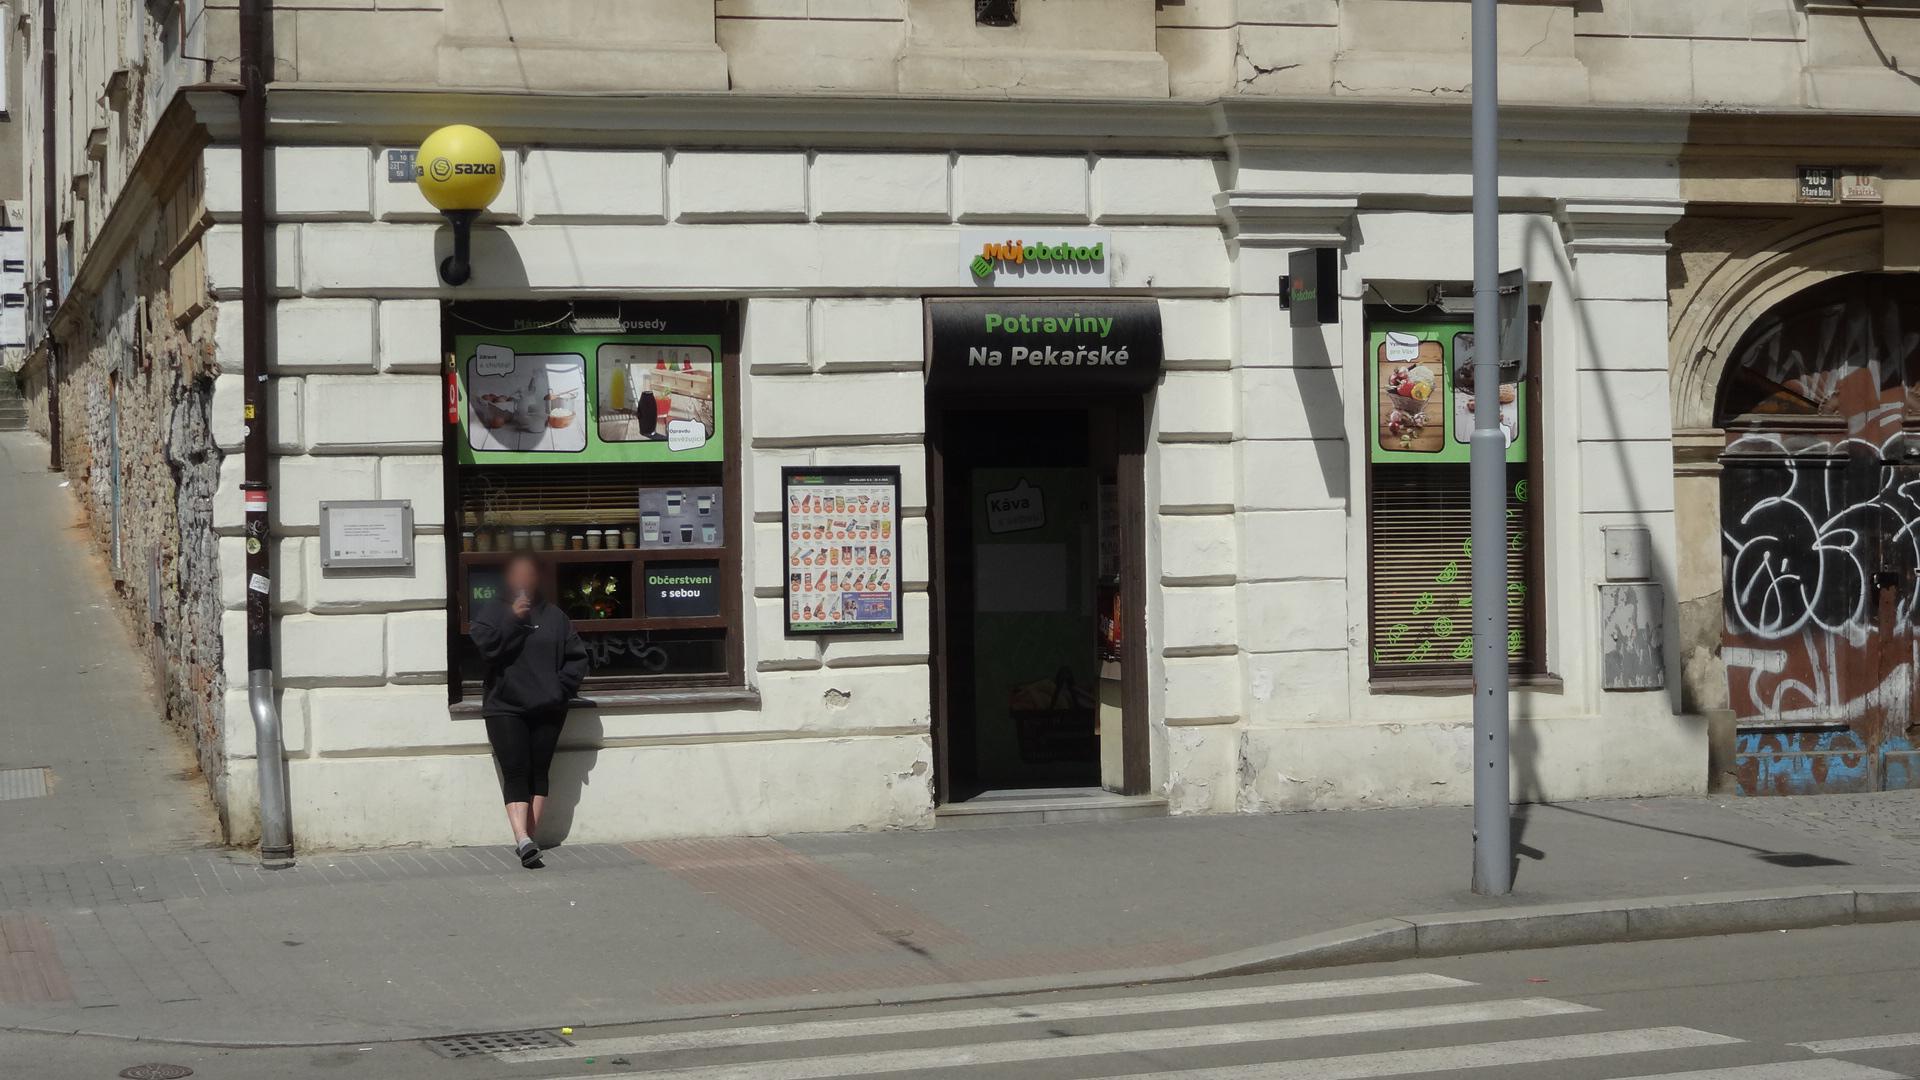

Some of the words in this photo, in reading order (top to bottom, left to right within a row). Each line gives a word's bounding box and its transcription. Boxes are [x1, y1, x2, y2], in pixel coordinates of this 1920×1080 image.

[1801, 186, 1818, 197] Staré
[985, 312, 1113, 338] Potraviny
[969, 345, 1002, 367] Na
[1010, 345, 1129, 367] Pekařské
[991, 497, 1030, 512] Káva
[648, 573, 713, 586] Občerstvení
[661, 589, 667, 598] s
[669, 587, 701, 598] sebou
